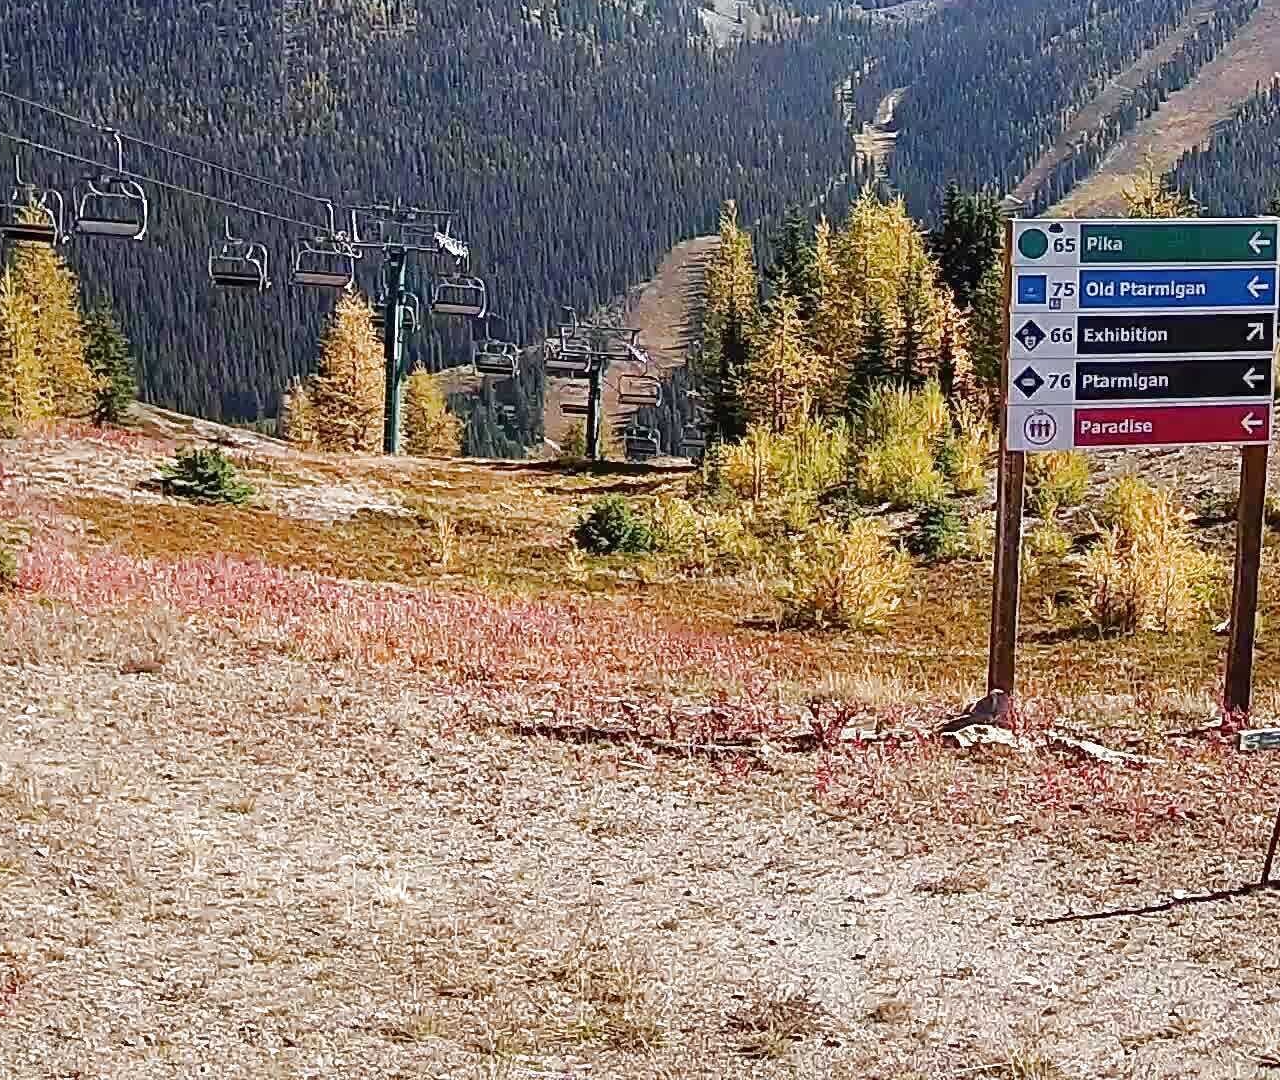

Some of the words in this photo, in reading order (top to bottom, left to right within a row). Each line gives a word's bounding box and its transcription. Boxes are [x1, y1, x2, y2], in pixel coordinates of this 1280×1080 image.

[1053, 237, 1076, 253] 65
[1087, 236, 1123, 251] Pika
[1052, 282, 1075, 297] 75
[1086, 281, 1114, 297] Old
[1120, 280, 1206, 298] Ptarmigan
[1050, 328, 1073, 343] 66
[1084, 326, 1168, 343] Exhibition
[1048, 374, 1071, 389] 76
[1082, 372, 1169, 391] Ptarmigan
[1081, 418, 1153, 434] Paradise
